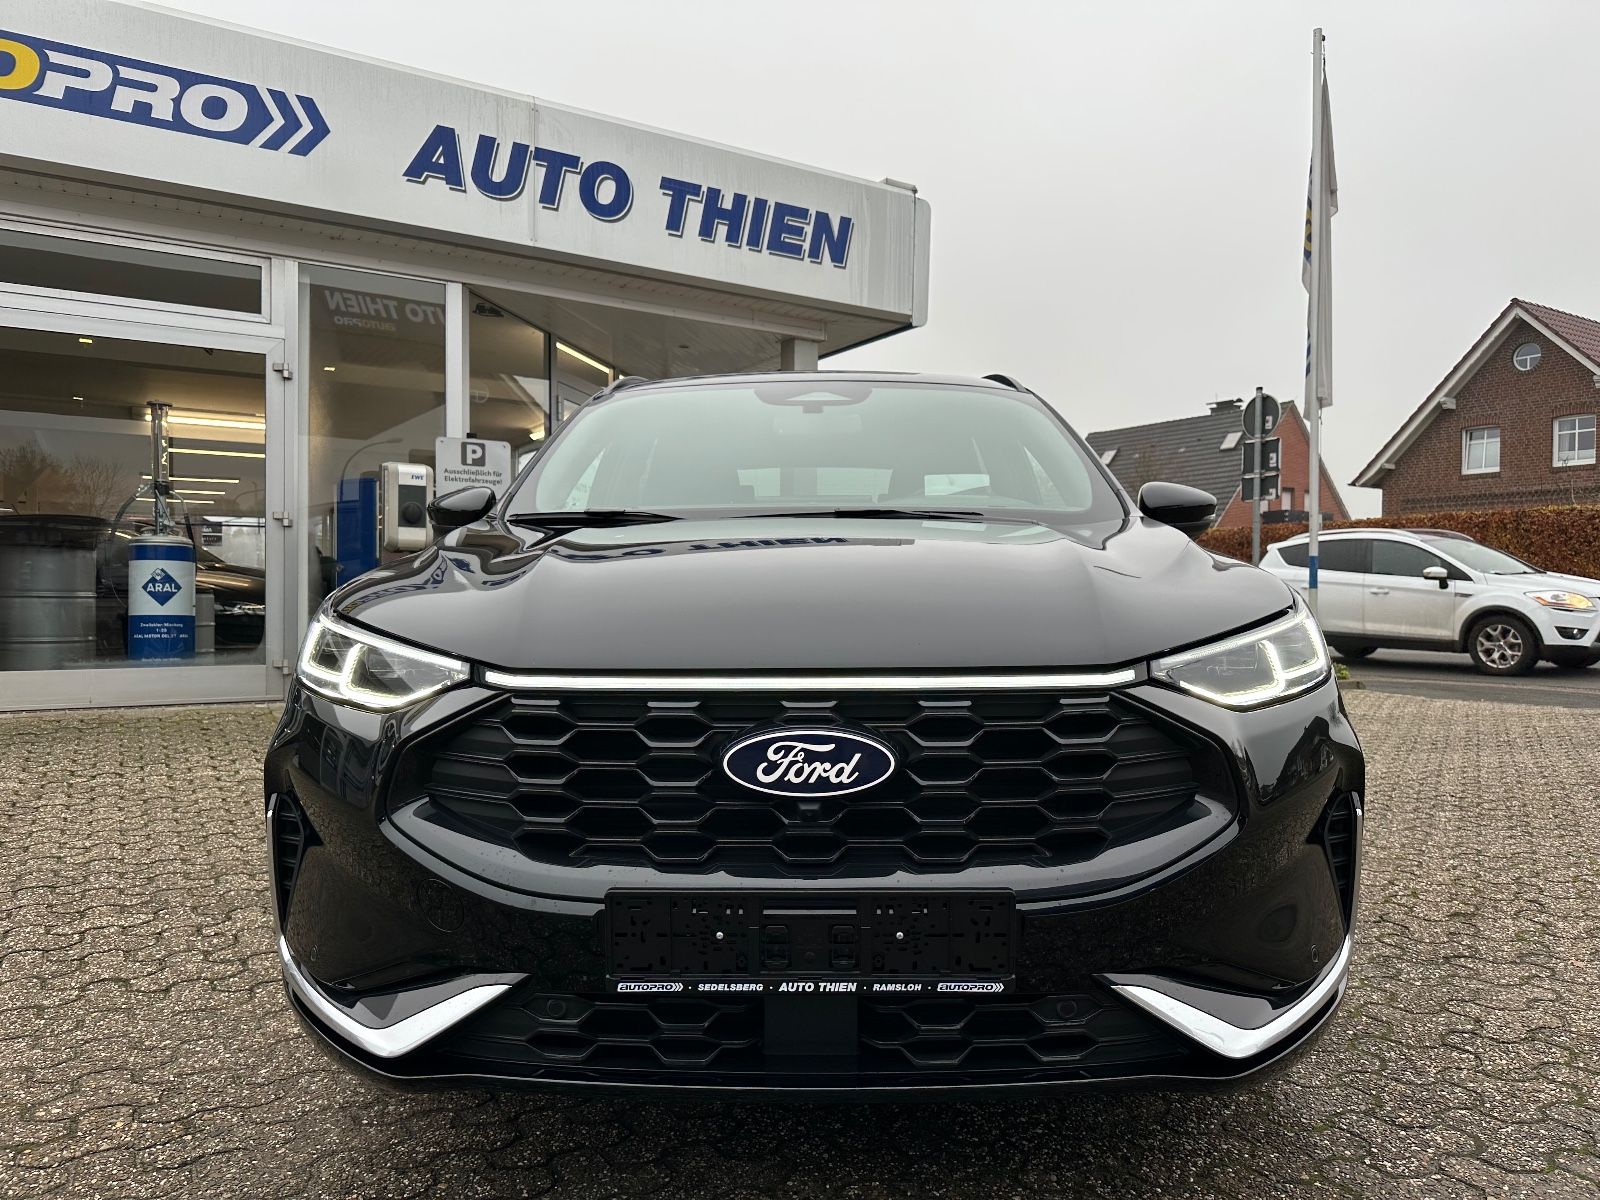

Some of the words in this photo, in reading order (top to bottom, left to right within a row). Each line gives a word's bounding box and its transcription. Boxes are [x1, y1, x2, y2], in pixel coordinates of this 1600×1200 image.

[402, 124, 634, 222] AUTO
[659, 175, 854, 268] THIEN
[466, 443, 483, 465] P
[492, 470, 503, 478] für
[146, 583, 178, 592] ARAL
[756, 741, 862, 784] Ford
[698, 983, 764, 991] SEDELSBERG
[778, 982, 815, 992] AUTO
[818, 982, 857, 992] THIEN
[872, 983, 922, 991] RAMSLOH
